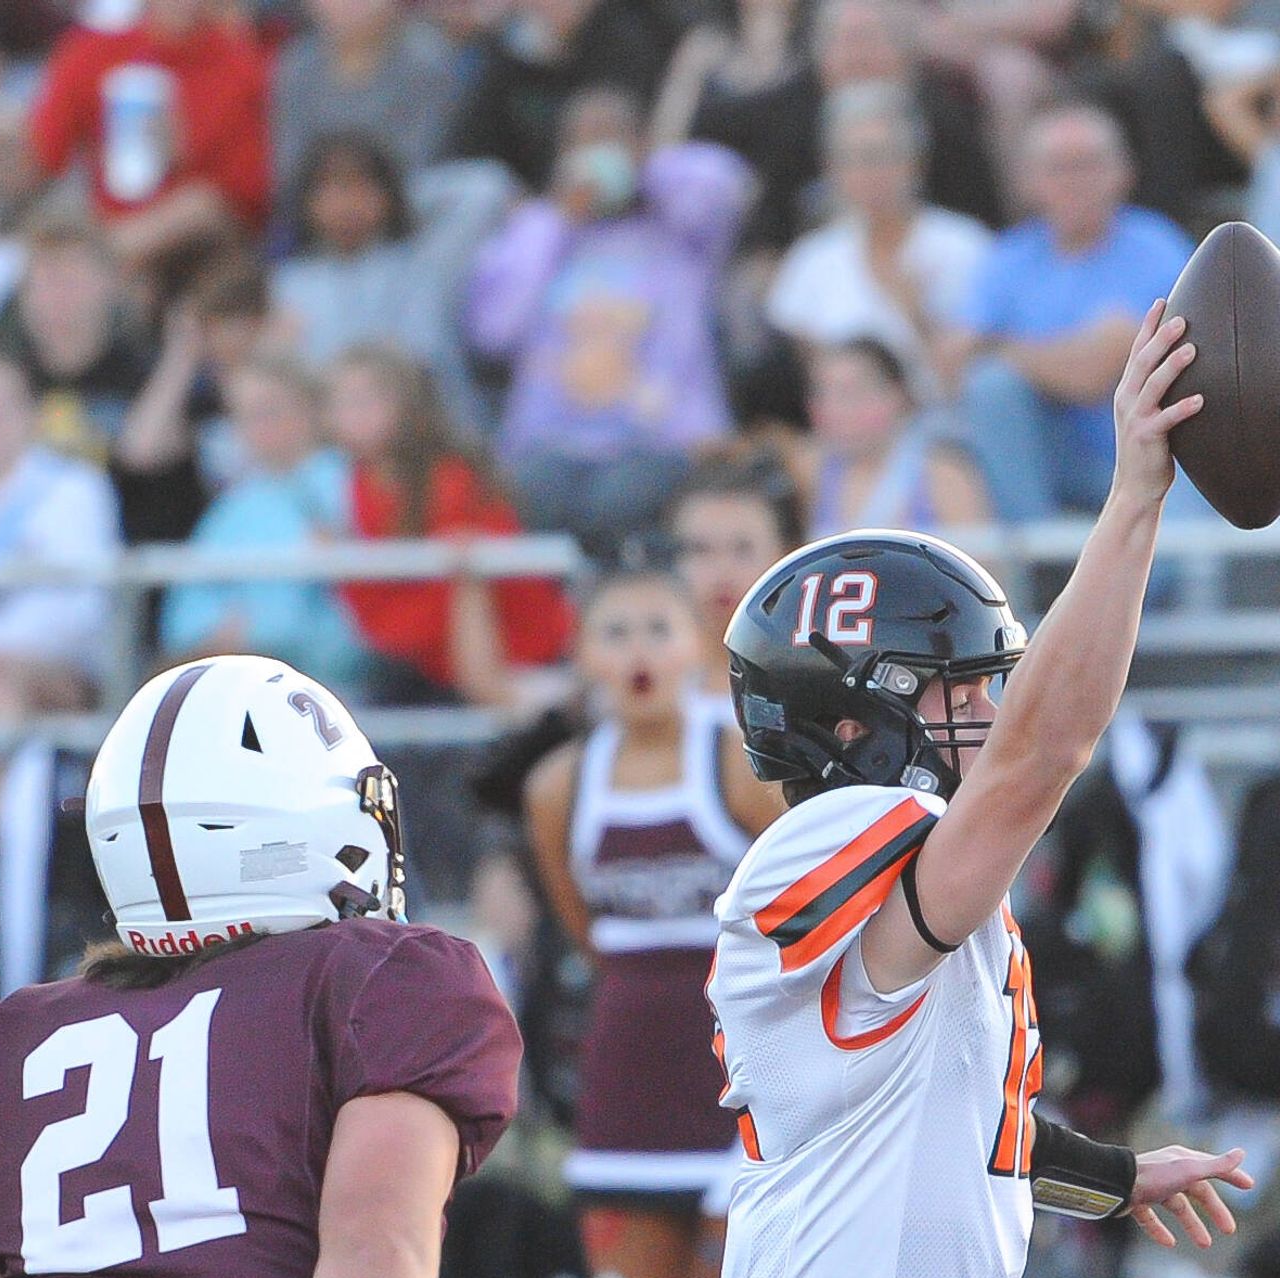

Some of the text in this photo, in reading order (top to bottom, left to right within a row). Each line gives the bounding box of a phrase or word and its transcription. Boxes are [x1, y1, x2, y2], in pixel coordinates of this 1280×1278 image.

[792, 569, 879, 646] 12
[287, 689, 344, 751] 2
[20, 987, 247, 1275] 21
